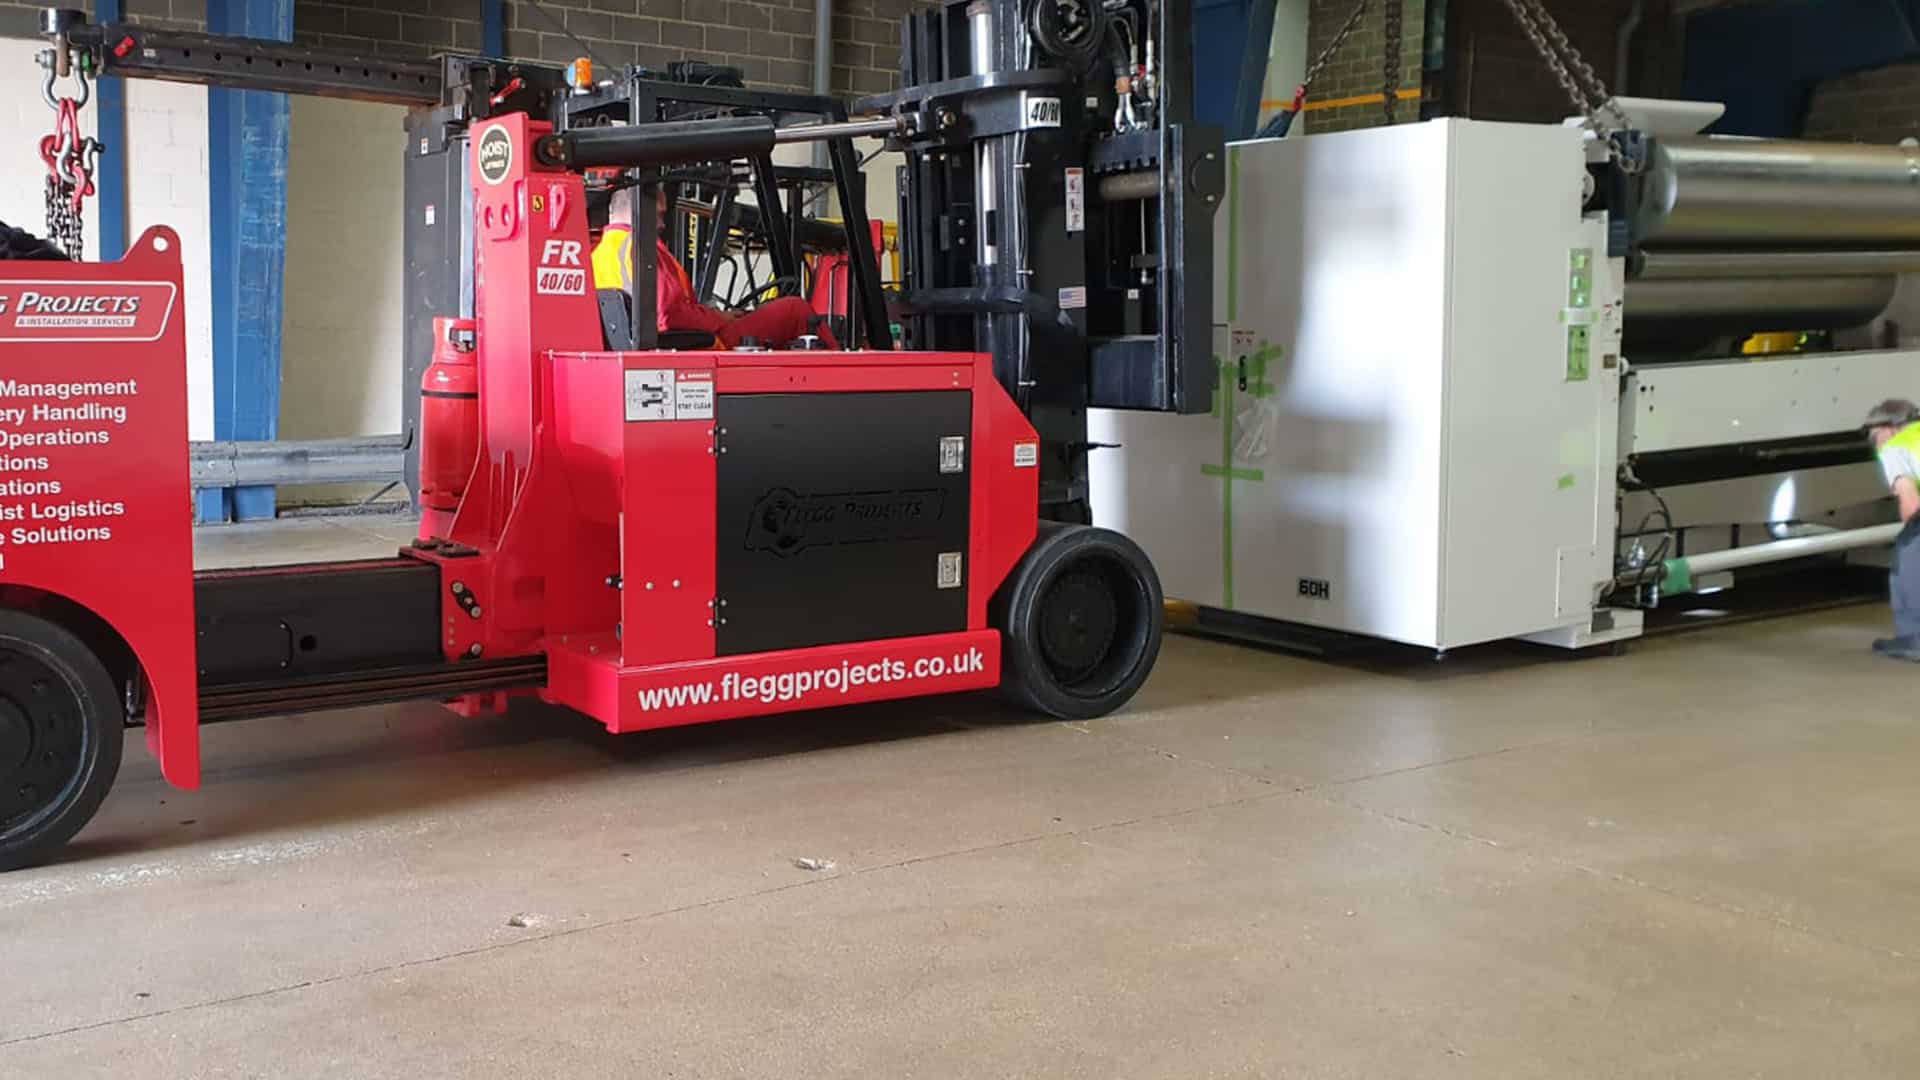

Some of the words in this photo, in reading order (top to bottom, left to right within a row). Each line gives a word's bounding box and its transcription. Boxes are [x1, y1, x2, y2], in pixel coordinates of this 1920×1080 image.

[481, 141, 509, 163] HOIST
[540, 239, 582, 266] FR
[539, 272, 583, 291] 40/60
[0, 379, 137, 400] Management
[32, 402, 127, 423] Handling
[31, 499, 125, 522] Logistics
[11, 524, 112, 545] Solutions
[1298, 577, 1330, 600] 60H
[638, 647, 984, 712] www.fleggprojects.co.uk
